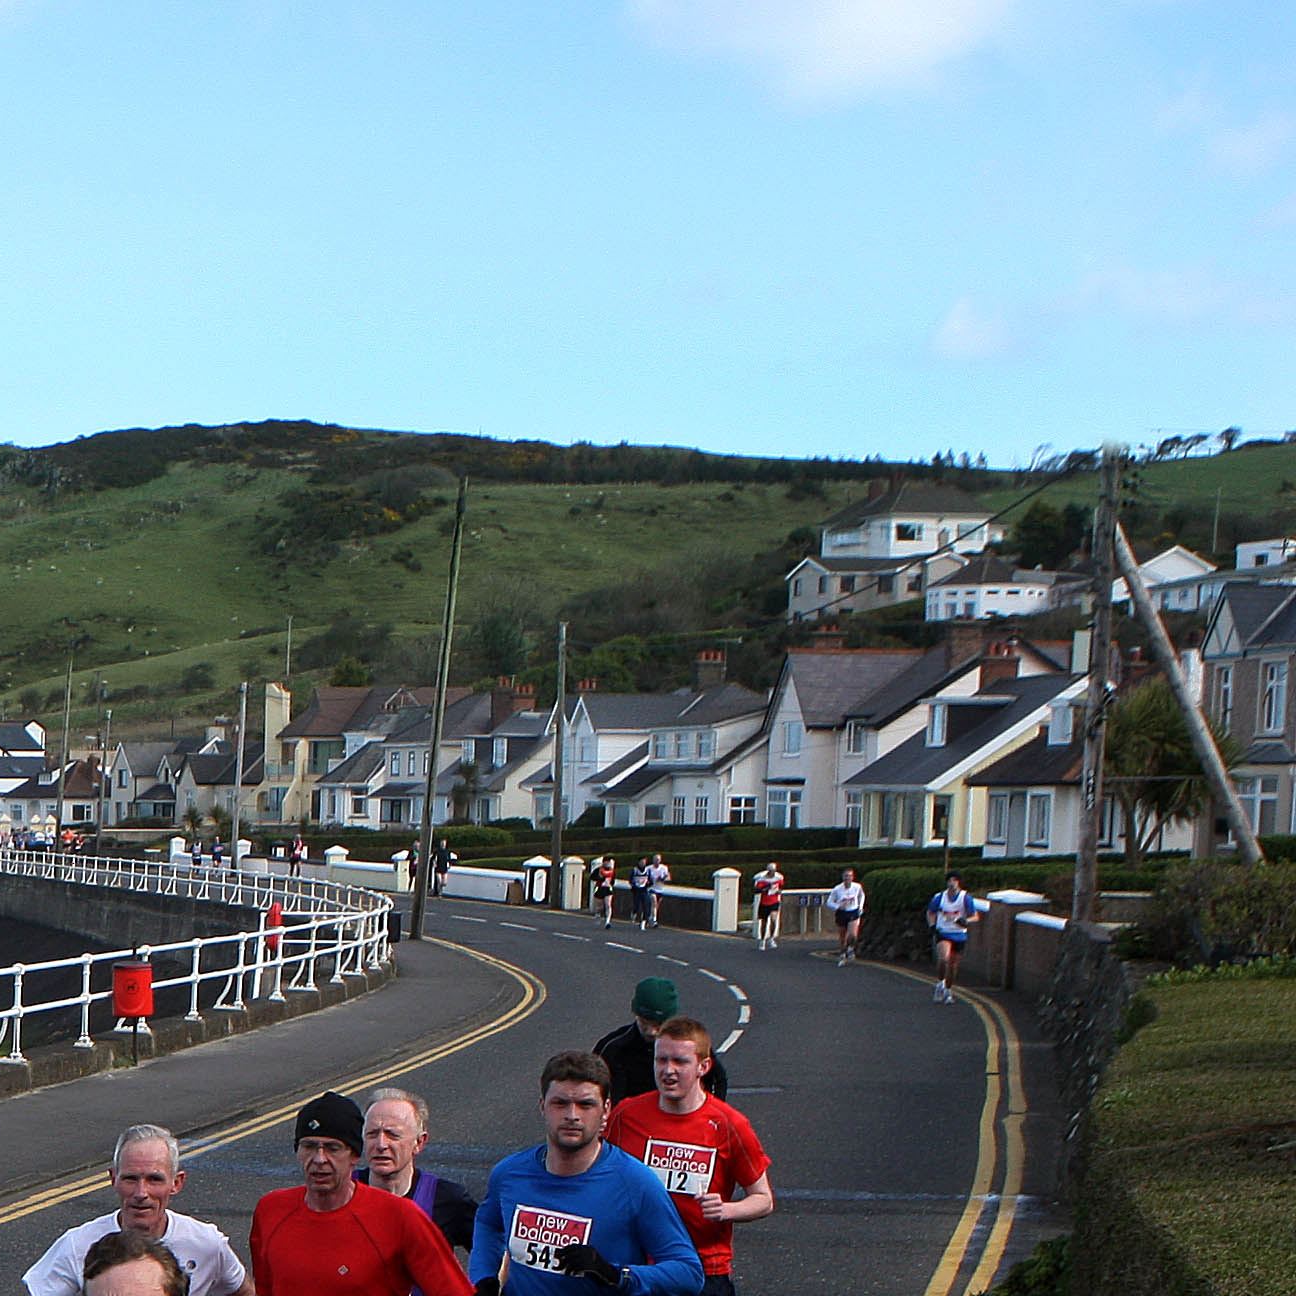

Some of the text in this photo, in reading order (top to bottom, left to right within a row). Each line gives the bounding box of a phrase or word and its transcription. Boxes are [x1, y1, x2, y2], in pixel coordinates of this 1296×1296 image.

[650, 1153, 707, 1174] balance
[666, 1146, 695, 1160] new
[667, 1170, 688, 1192] 12
[536, 1214, 568, 1231] new
[517, 1222, 580, 1246] balance
[525, 1242, 565, 1270] 545
